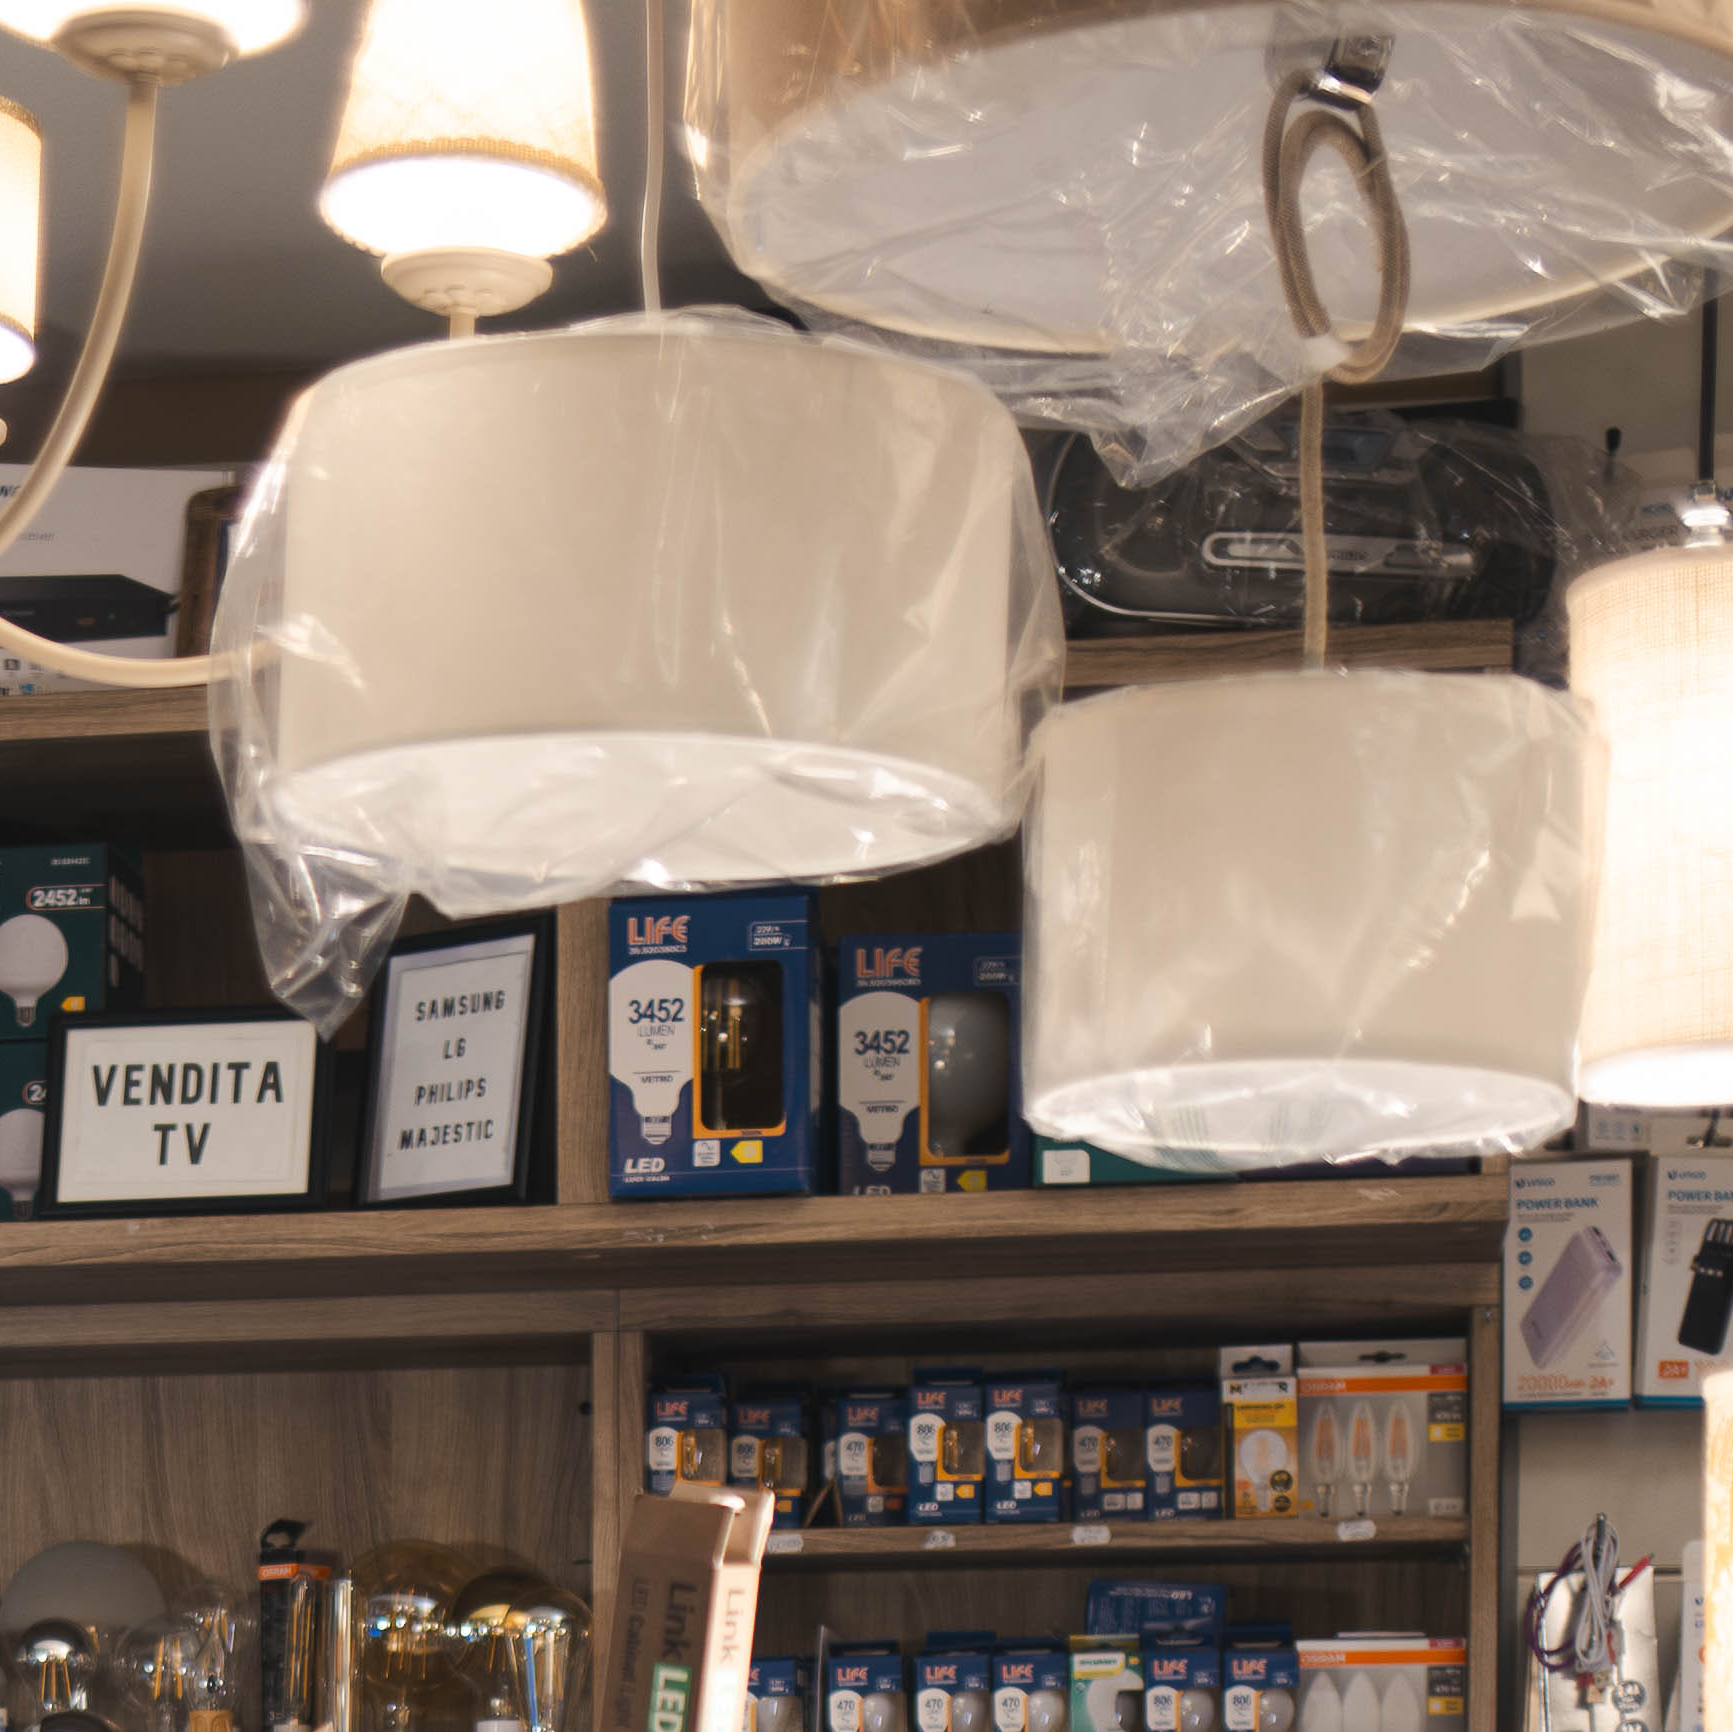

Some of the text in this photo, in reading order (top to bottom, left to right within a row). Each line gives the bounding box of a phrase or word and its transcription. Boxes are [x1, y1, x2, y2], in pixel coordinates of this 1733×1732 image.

[33, 889, 75, 908] 2452
[627, 915, 691, 947] LIFE
[855, 947, 923, 979] LIFE
[415, 989, 507, 1022] SAMSUNG
[628, 998, 685, 1024] 3452
[638, 1024, 676, 1038] LUMEN
[854, 1030, 911, 1055] 3452
[92, 1061, 284, 1106] VENDITA
[415, 1078, 487, 1106] PHILIPS
[399, 1119, 494, 1150] MAJESTIC
[152, 1122, 211, 1165] TV
[624, 1157, 666, 1174] LED
[1516, 1196, 1599, 1210] POWER BANK
[1668, 1190, 1710, 1201] POWER
[917, 1391, 946, 1406] LIFE
[994, 1389, 1022, 1403] LIFE
[655, 1401, 689, 1417] LIFE
[917, 1424, 935, 1435] 806
[994, 1422, 1012, 1433] 806
[655, 1436, 674, 1448] 806
[664, 1581, 697, 1661] Link
[722, 1587, 745, 1663] Link
[837, 1668, 868, 1682] LIFE
[925, 1666, 957, 1680] LIFE
[1002, 1665, 1034, 1680] LIFE
[1154, 1659, 1187, 1675] LIFE
[1232, 1659, 1266, 1675] LIFE
[837, 1700, 855, 1711] 470
[925, 1699, 944, 1710] 470
[1002, 1698, 1020, 1709] 470
